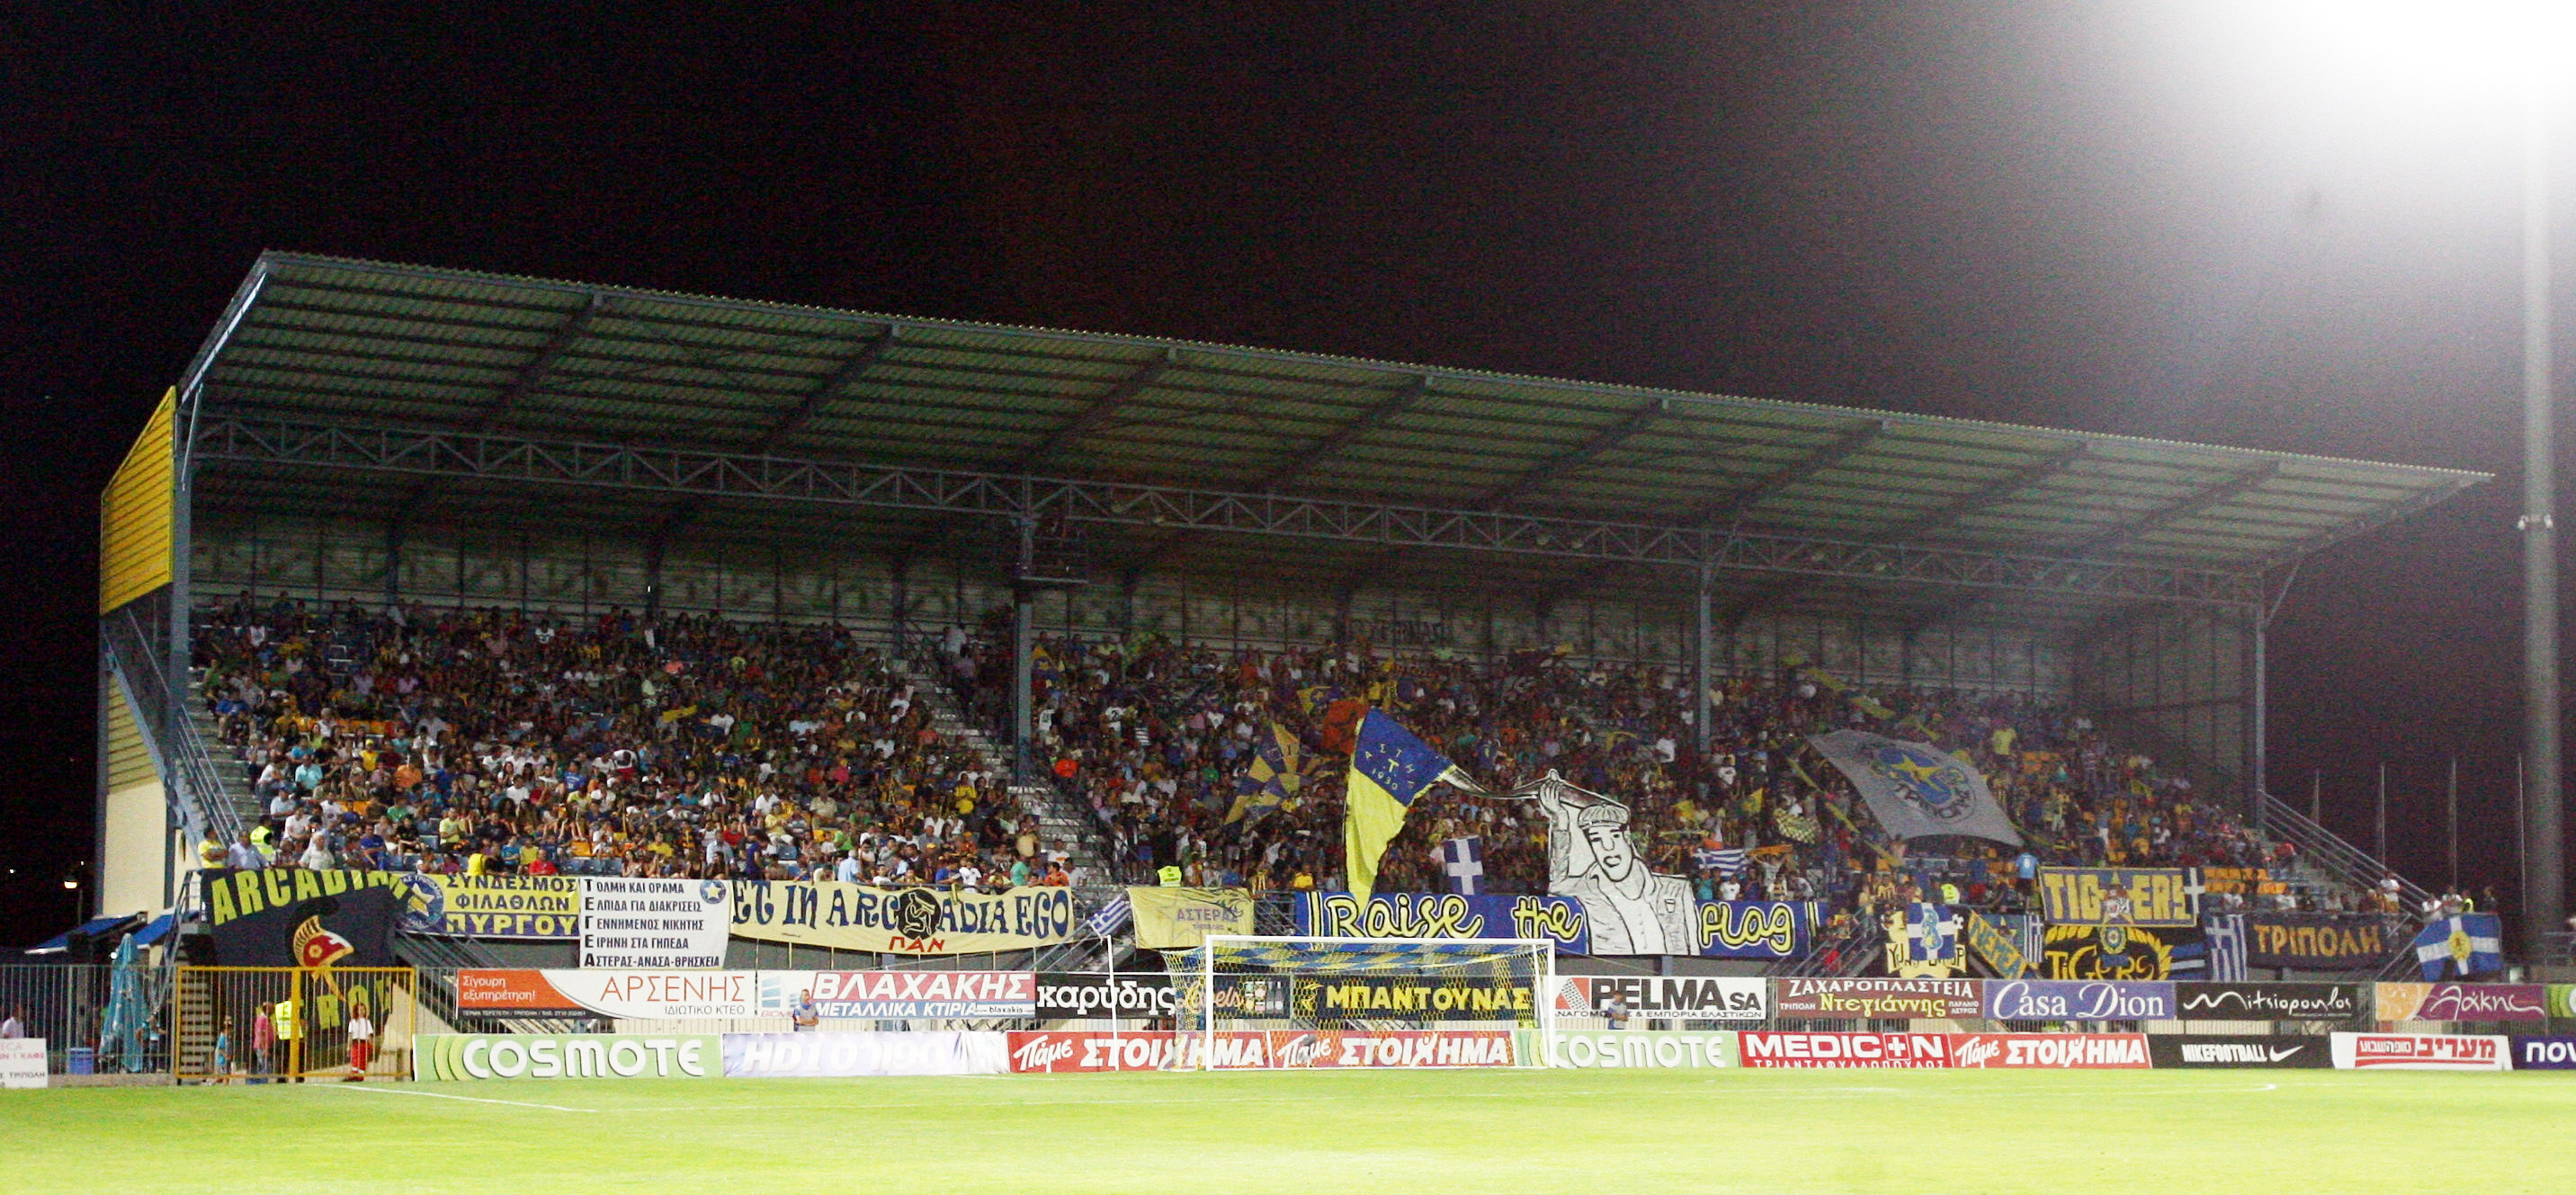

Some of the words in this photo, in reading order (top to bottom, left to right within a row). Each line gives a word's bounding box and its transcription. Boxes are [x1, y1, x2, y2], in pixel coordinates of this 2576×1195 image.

[446, 873, 577, 892] ΣΥΝΔΕΣΜΟΣ
[629, 882, 646, 893] ΚΑΙ
[648, 882, 684, 894] ΟΡΑΜΑ
[455, 893, 569, 911] ΦΙΛΑΘΛΩΝ
[631, 901, 646, 912] ΓΙΑ
[648, 901, 702, 912] ΔΙΑΚΡΙΣΕΙΣ
[732, 880, 774, 925] ET
[1015, 889, 1069, 939] EGO
[445, 913, 577, 935] ΠΥΡΓΟΥ
[663, 919, 704, 931] ΝΙΚΗΤΗΣ
[1324, 894, 1484, 938] Raise
[1511, 896, 1583, 944] the
[631, 938, 648, 949] ΣΤΑ
[651, 938, 689, 950] ΓΗΠΕΔΑ
[889, 936, 945, 952] ΠΑΝ
[2253, 923, 2383, 959] ΤΡΙΠΟΛΗ
[462, 976, 506, 988] Σίγουρη
[599, 976, 745, 1002] ΑΡΣΕΝΗΣ
[812, 973, 1032, 1001] ΒΛΑΧΑΚΗΣ
[1788, 979, 1974, 998] ΖΑΧΑΡΟΠΛΑΣΤΕΙΑ
[462, 989, 536, 1002] εξυπηρέτηση!
[1037, 978, 1176, 1016] καρύδης
[1327, 985, 1532, 1011] ΜΠΑΝΤΟΥΝΑΣ
[1591, 978, 1728, 1011] PELMA
[1730, 992, 1762, 1011] SA
[1780, 1002, 1816, 1011] ΤΡΙΠΟΛΗ
[1820, 993, 1946, 1018] Ντεγιάννης
[1993, 982, 2068, 1020] Casa
[2076, 981, 2165, 1020] Dion
[664, 1005, 712, 1015] ΙΔΙΩΤΙΚΟ
[716, 1005, 745, 1015] ΚΤΕΟ
[815, 1002, 917, 1017] ΜΕΤΑΛΛΙΚΑ
[923, 1002, 978, 1017] ΚΤΙΡΙΑ
[462, 1039, 705, 1077] COSMOTE
[1013, 1034, 1074, 1074] Πάμε
[1080, 1036, 1266, 1071] ΣΤΟΙΧΗΜΑ
[1340, 1035, 1508, 1068] ΣΤΟΙΧΗΜΑ
[1554, 1034, 1726, 1067] COSMOTE
[1954, 1035, 2000, 1068] Πάμε
[2007, 1035, 2146, 1067] ΣΤΟΙΧΗΜΑ
[2181, 1043, 2267, 1062] NIKEFOOTBALL
[2417, 1038, 2496, 1057] מעריב
